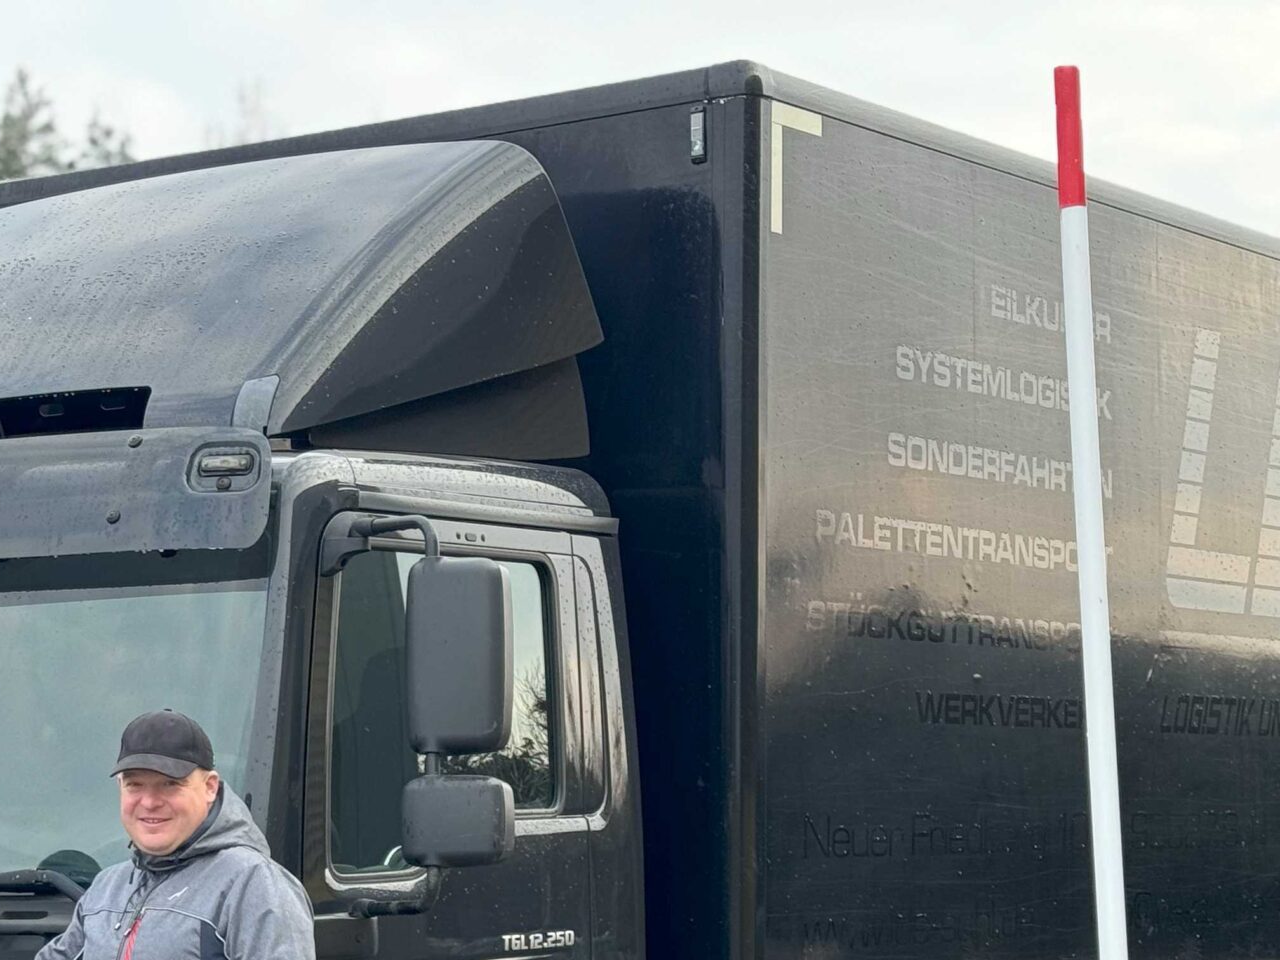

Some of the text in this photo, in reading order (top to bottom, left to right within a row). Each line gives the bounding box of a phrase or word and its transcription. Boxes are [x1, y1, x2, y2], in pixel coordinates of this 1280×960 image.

[991, 284, 1111, 344] EILKUR
[896, 343, 1113, 420] SYSTEMLOGISK
[887, 432, 1113, 499] SONDERFAHRN
[1160, 694, 1251, 737] LOGISTIK
[502, 933, 528, 951] TGL
